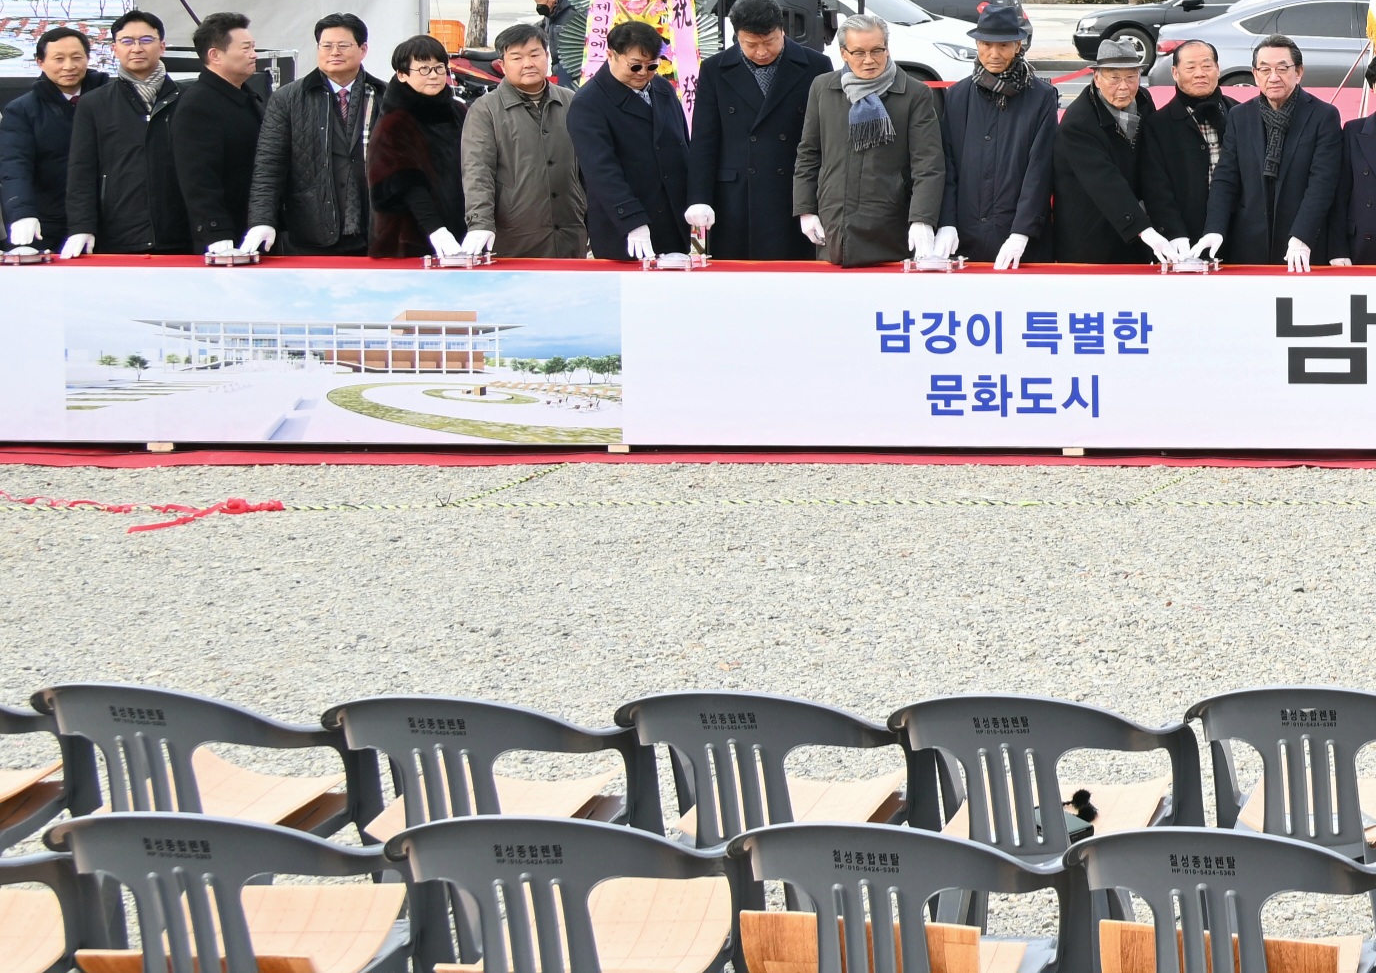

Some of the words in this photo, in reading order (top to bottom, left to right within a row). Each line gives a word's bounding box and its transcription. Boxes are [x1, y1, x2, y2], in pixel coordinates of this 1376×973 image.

[875, 311, 1003, 355] 남강이
[1021, 311, 1153, 355] 특별한
[926, 373, 1100, 418] 문화도시
[700, 712, 756, 724] 칠성종합렌탈
[1280, 709, 1336, 721] 칠성종합렌탈
[408, 717, 466, 729] 칠성종합렌탈
[973, 716, 1029, 729] 칠성종합렌탈
[494, 844, 562, 857] 칠성종합렌탈
[833, 849, 899, 866] 칠성종합렌탈
[1170, 854, 1235, 869] 칠성종합렌탈
